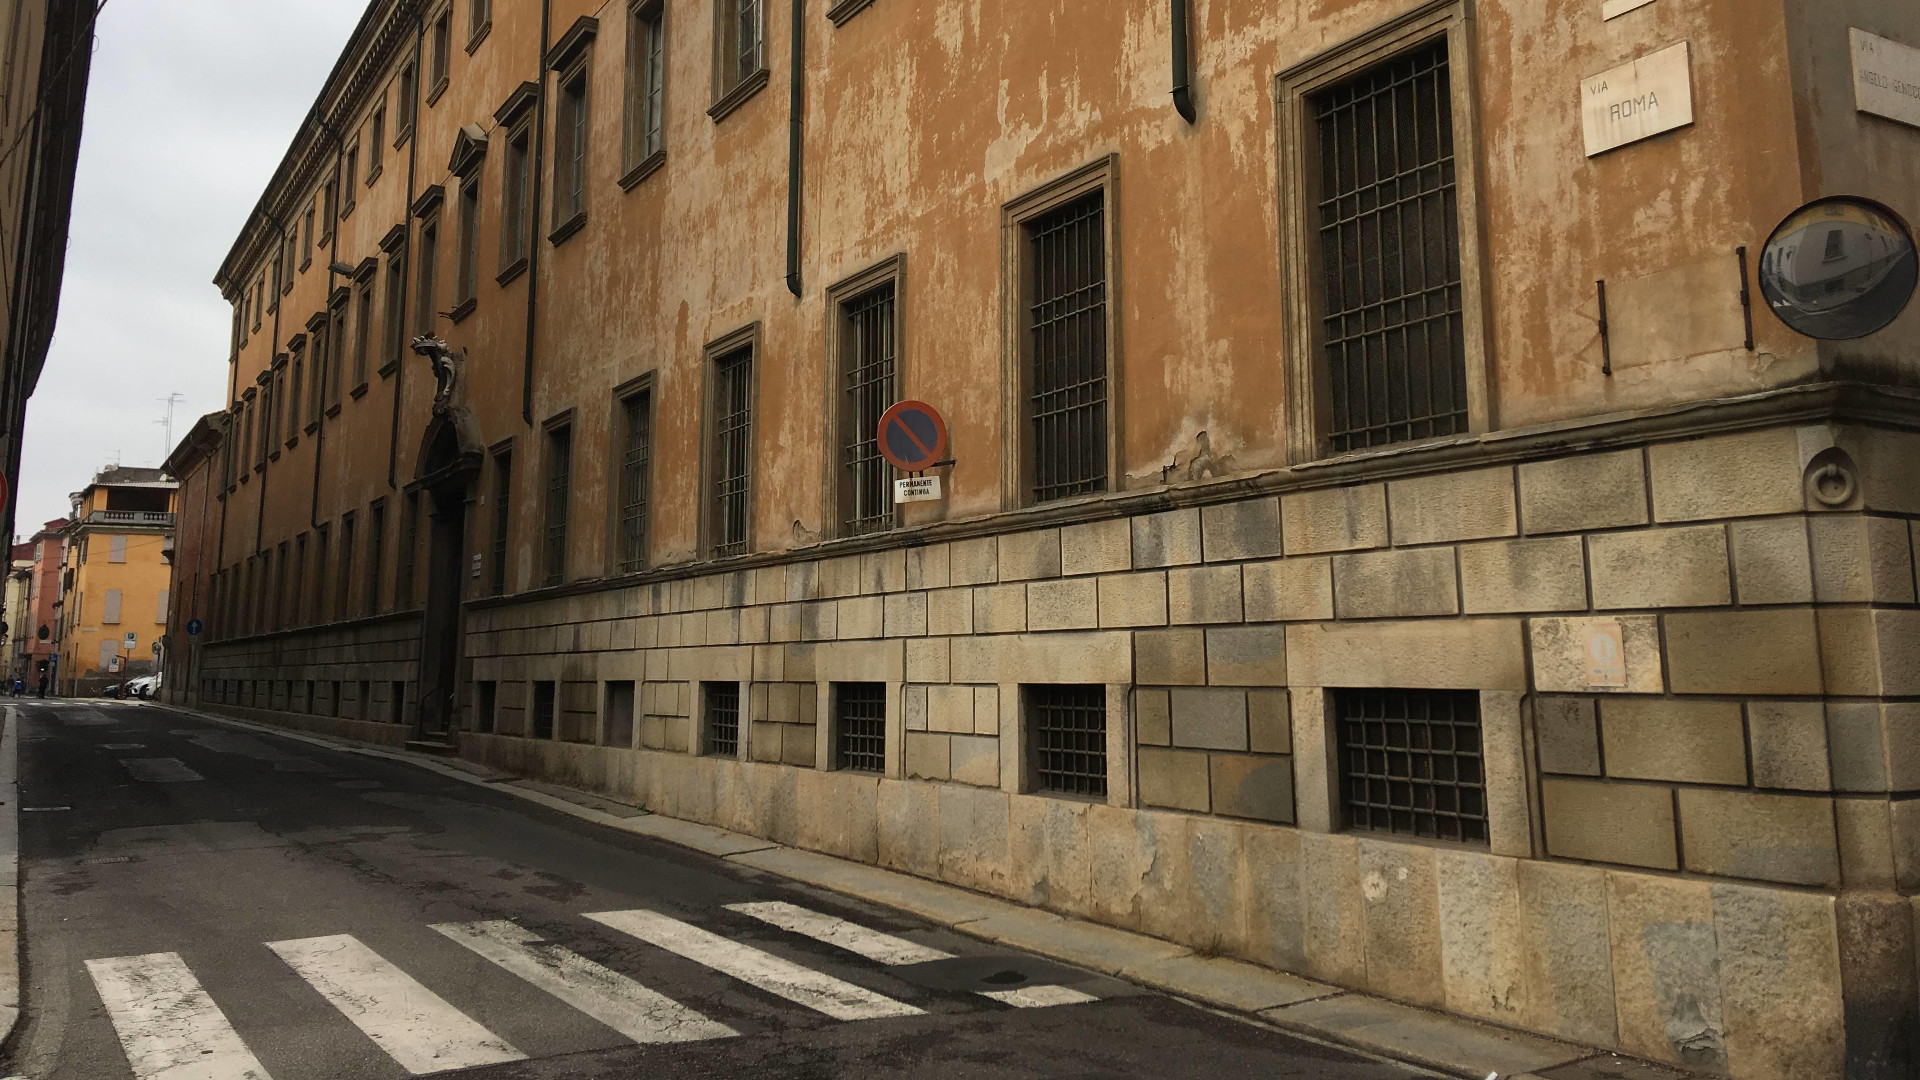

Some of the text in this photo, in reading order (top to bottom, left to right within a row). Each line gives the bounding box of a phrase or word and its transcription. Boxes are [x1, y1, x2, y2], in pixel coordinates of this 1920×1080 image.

[1860, 40, 1874, 53] VIA
[1859, 68, 1888, 89] ANGELO
[1590, 80, 1608, 95] VIA
[1610, 91, 1659, 122] ROMA
[899, 480, 932, 488] PERMANENTE
